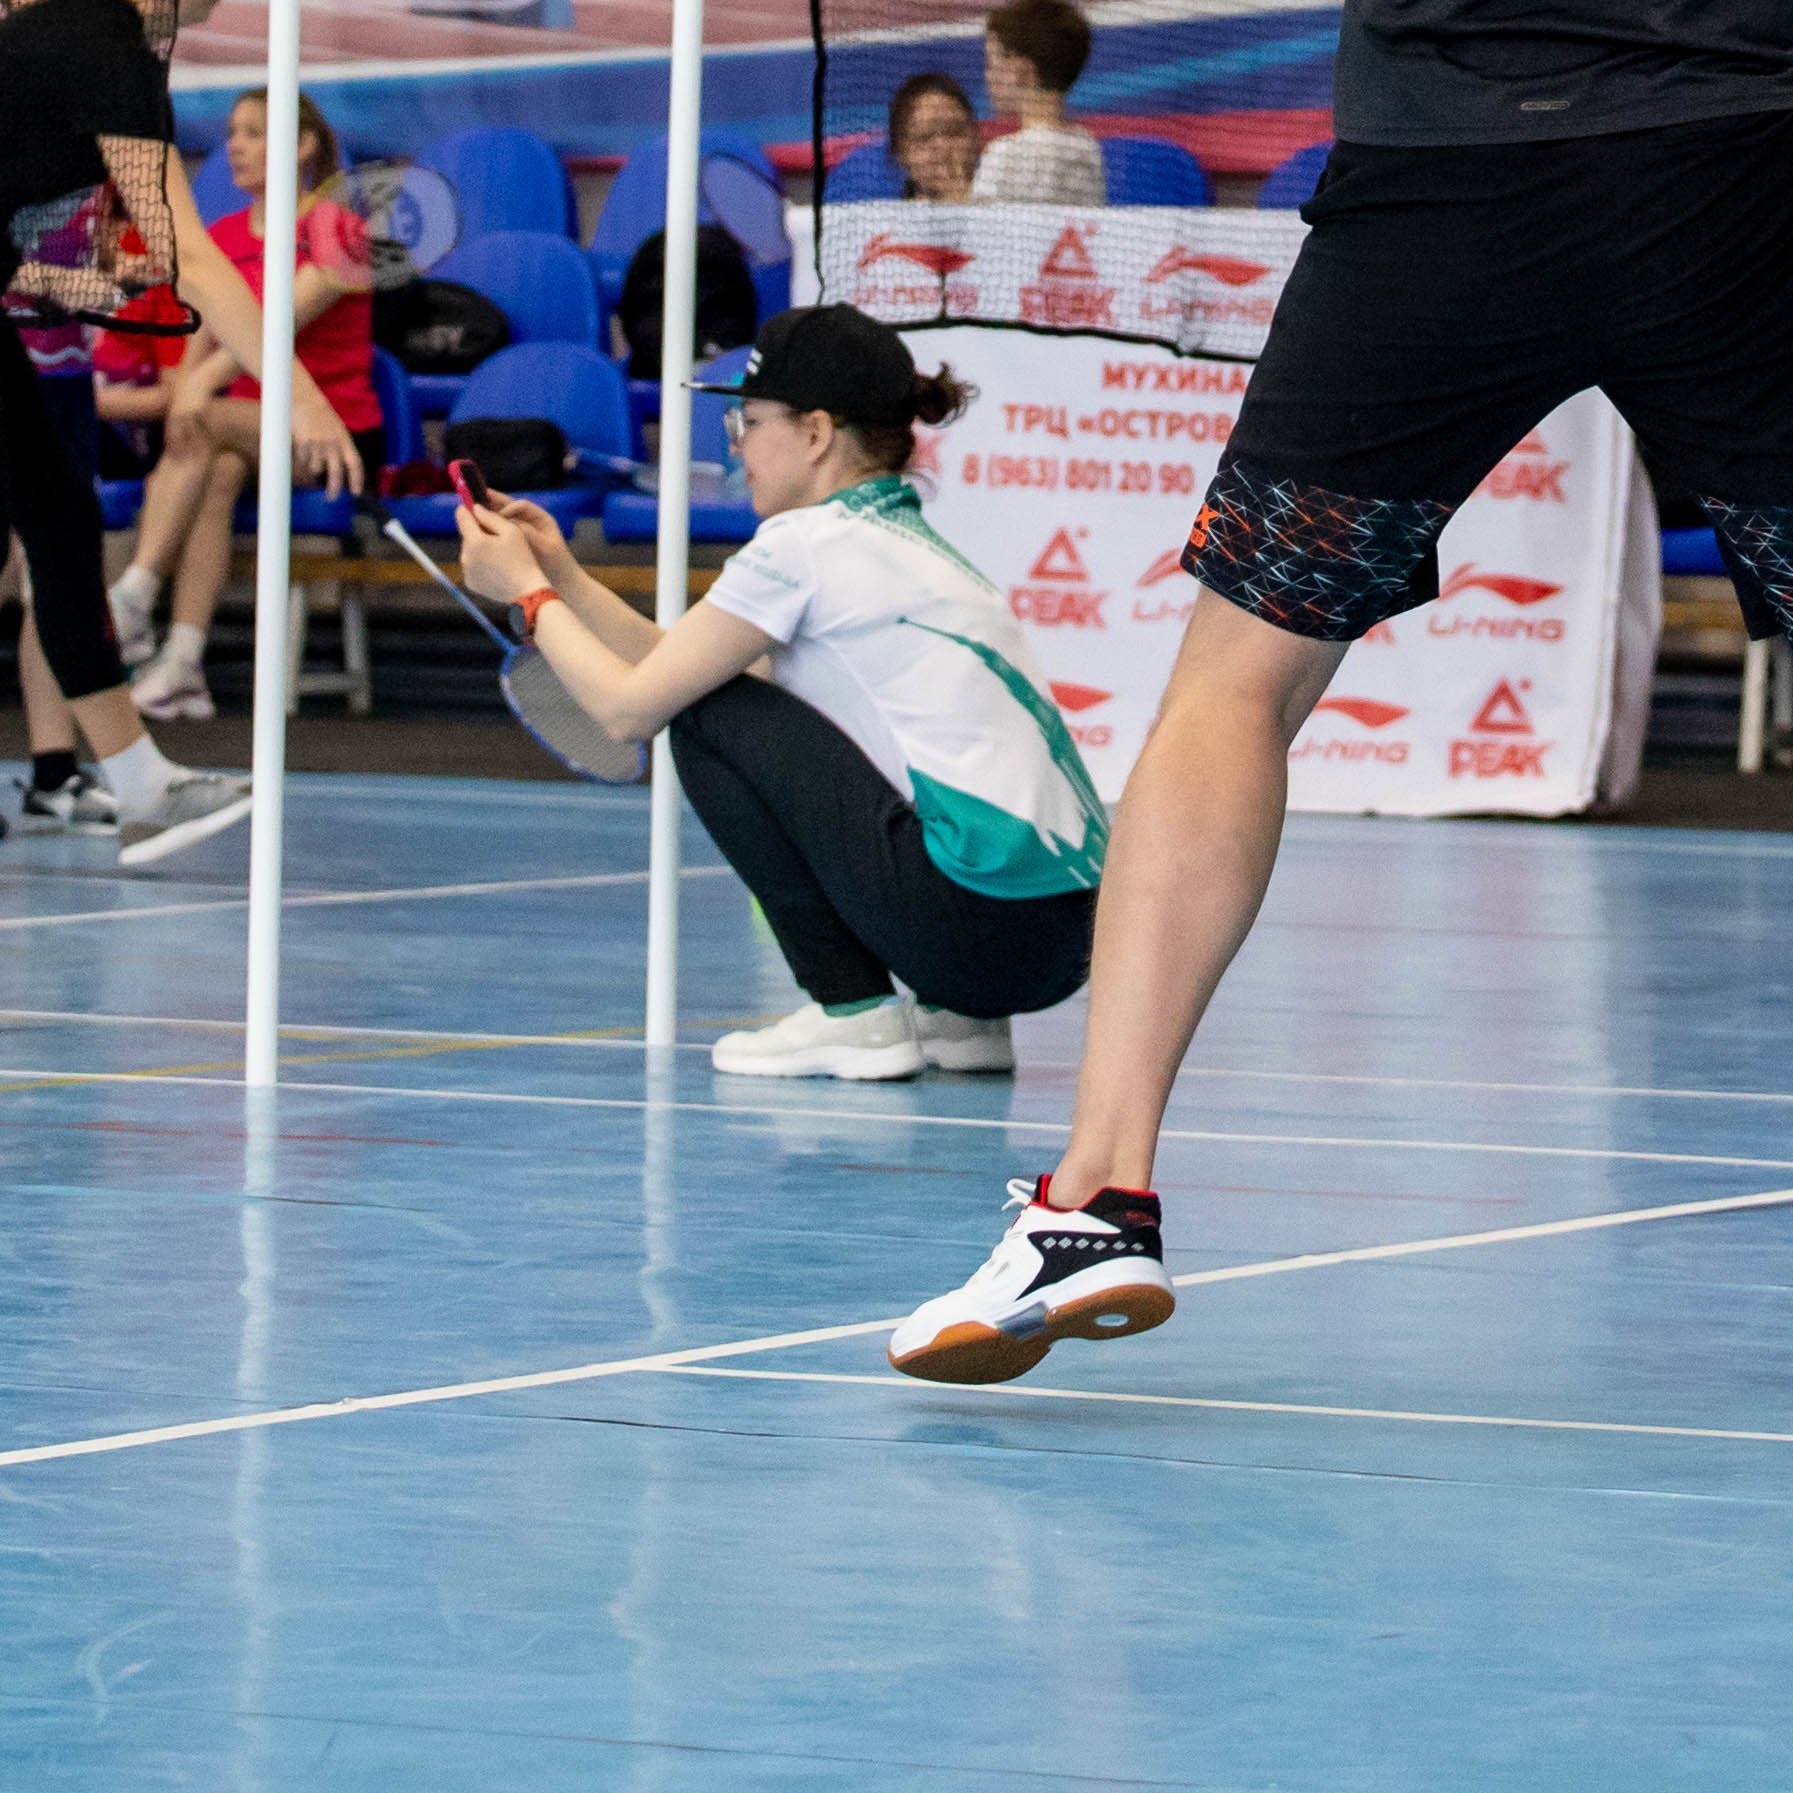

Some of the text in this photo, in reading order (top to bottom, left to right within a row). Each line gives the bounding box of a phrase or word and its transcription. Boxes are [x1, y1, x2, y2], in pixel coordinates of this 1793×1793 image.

[1102, 361, 1247, 395] МУХИНА
[1003, 401, 1068, 440] ТРЦ
[962, 453, 980, 485] 8
[1065, 458, 1111, 493] 801
[1117, 460, 1152, 494] 20
[1159, 462, 1196, 495] 90
[1009, 586, 1110, 629] PEAK
[1448, 738, 1552, 780] PEAK
